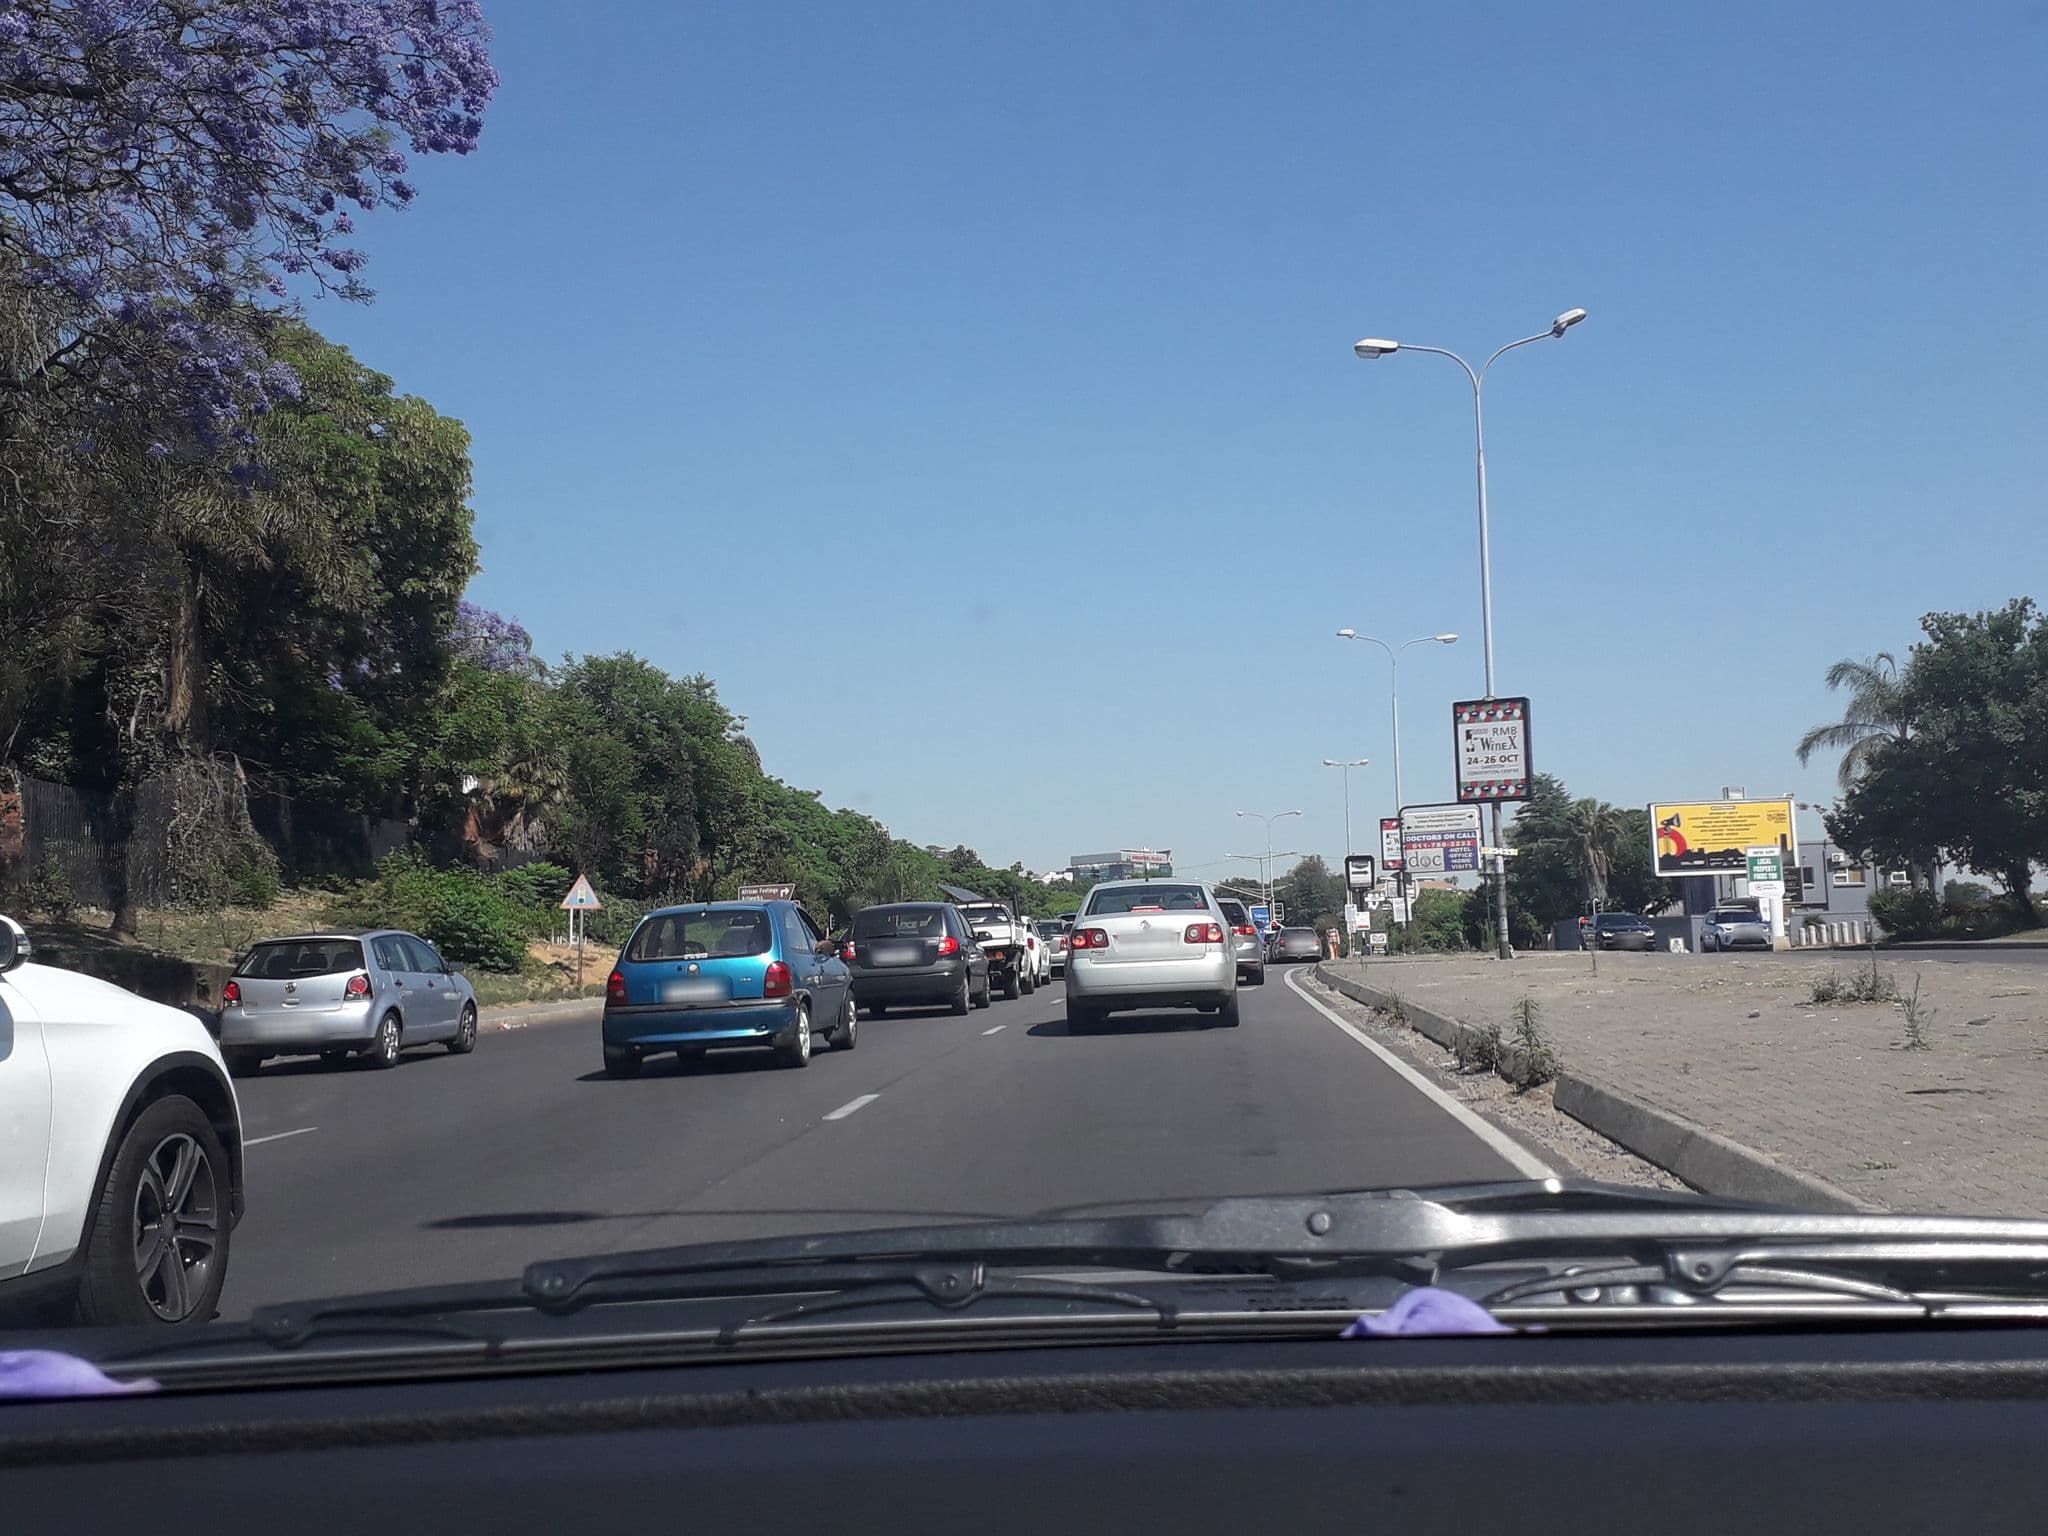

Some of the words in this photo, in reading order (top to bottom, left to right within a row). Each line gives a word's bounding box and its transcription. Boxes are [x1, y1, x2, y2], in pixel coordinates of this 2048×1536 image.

[1492, 726, 1517, 736] RMB
[1467, 755, 1496, 765] 24-26
[1499, 754, 1519, 763] OCT
[1406, 834, 1442, 842] DOCTORS
[1408, 851, 1442, 868] doc
